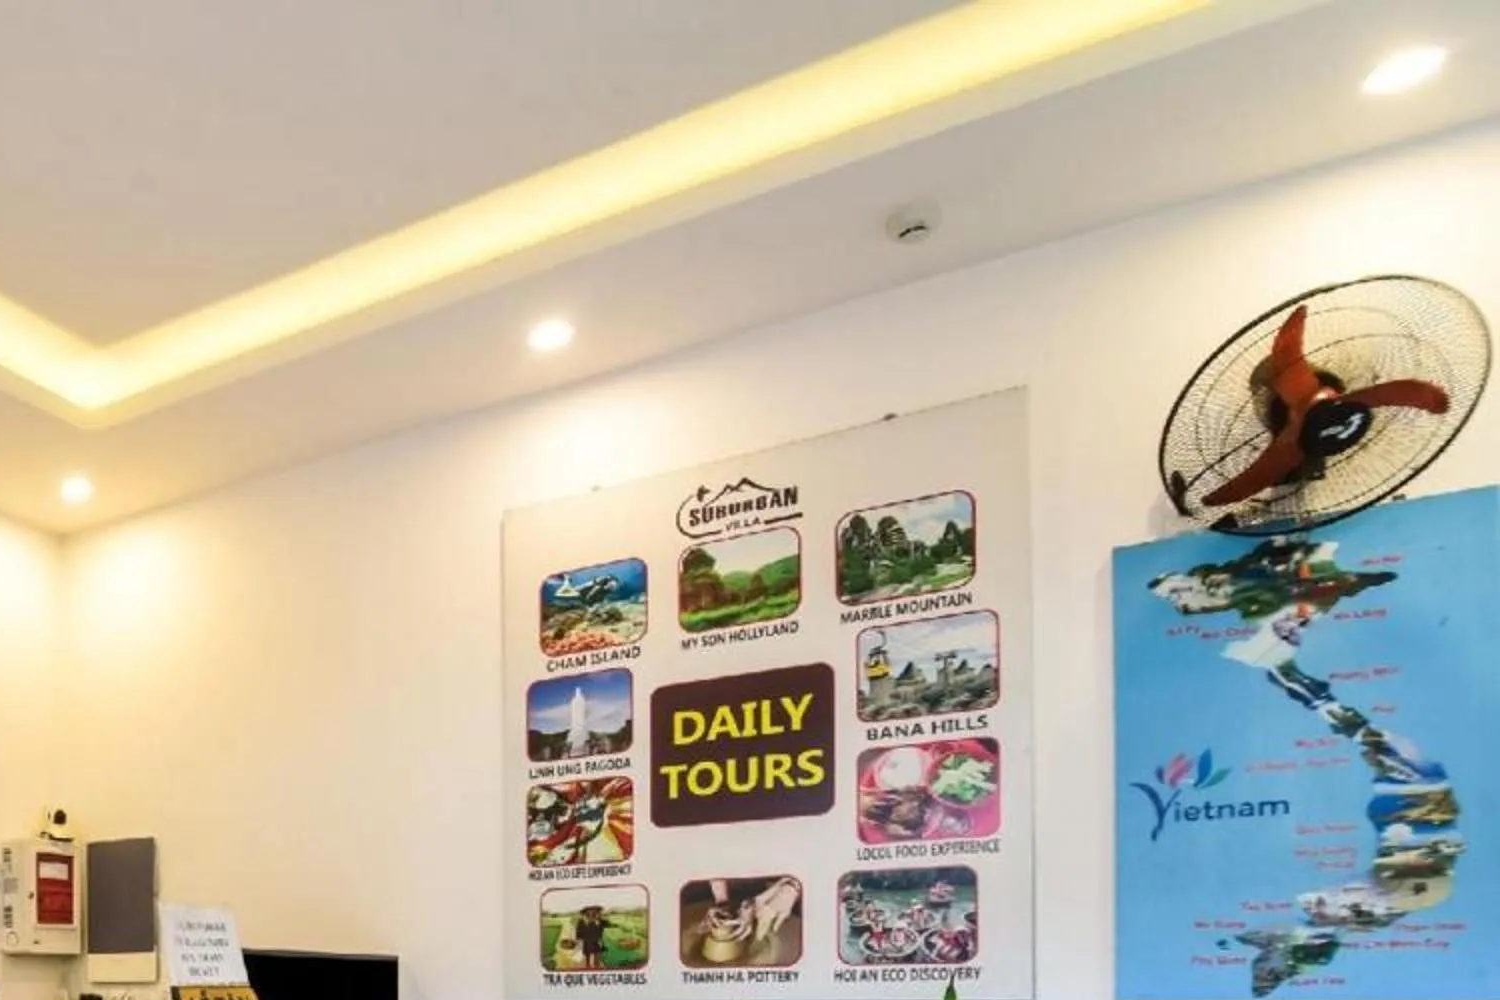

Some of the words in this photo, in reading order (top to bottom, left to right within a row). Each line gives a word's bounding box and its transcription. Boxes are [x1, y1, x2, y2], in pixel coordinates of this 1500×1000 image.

[688, 486, 799, 527] SUBURBAN
[840, 603, 892, 624] MARBLE
[895, 592, 972, 615] MOUNTAIN
[546, 654, 587, 672] CHAM
[590, 645, 641, 665] ISLAND
[673, 692, 814, 745] DAILY
[866, 723, 925, 741] BANA
[931, 714, 988, 735] HILLS
[585, 757, 631, 772] PAGODA
[659, 749, 825, 800] TOURS
[1128, 782, 1290, 842] Vietnam
[895, 843, 928, 858] FOOD
[681, 971, 724, 984] THANH
[747, 970, 799, 983] POTTERY
[859, 968, 878, 982] AN
[881, 967, 908, 981] ECO
[910, 966, 982, 981] DISCOVERY
